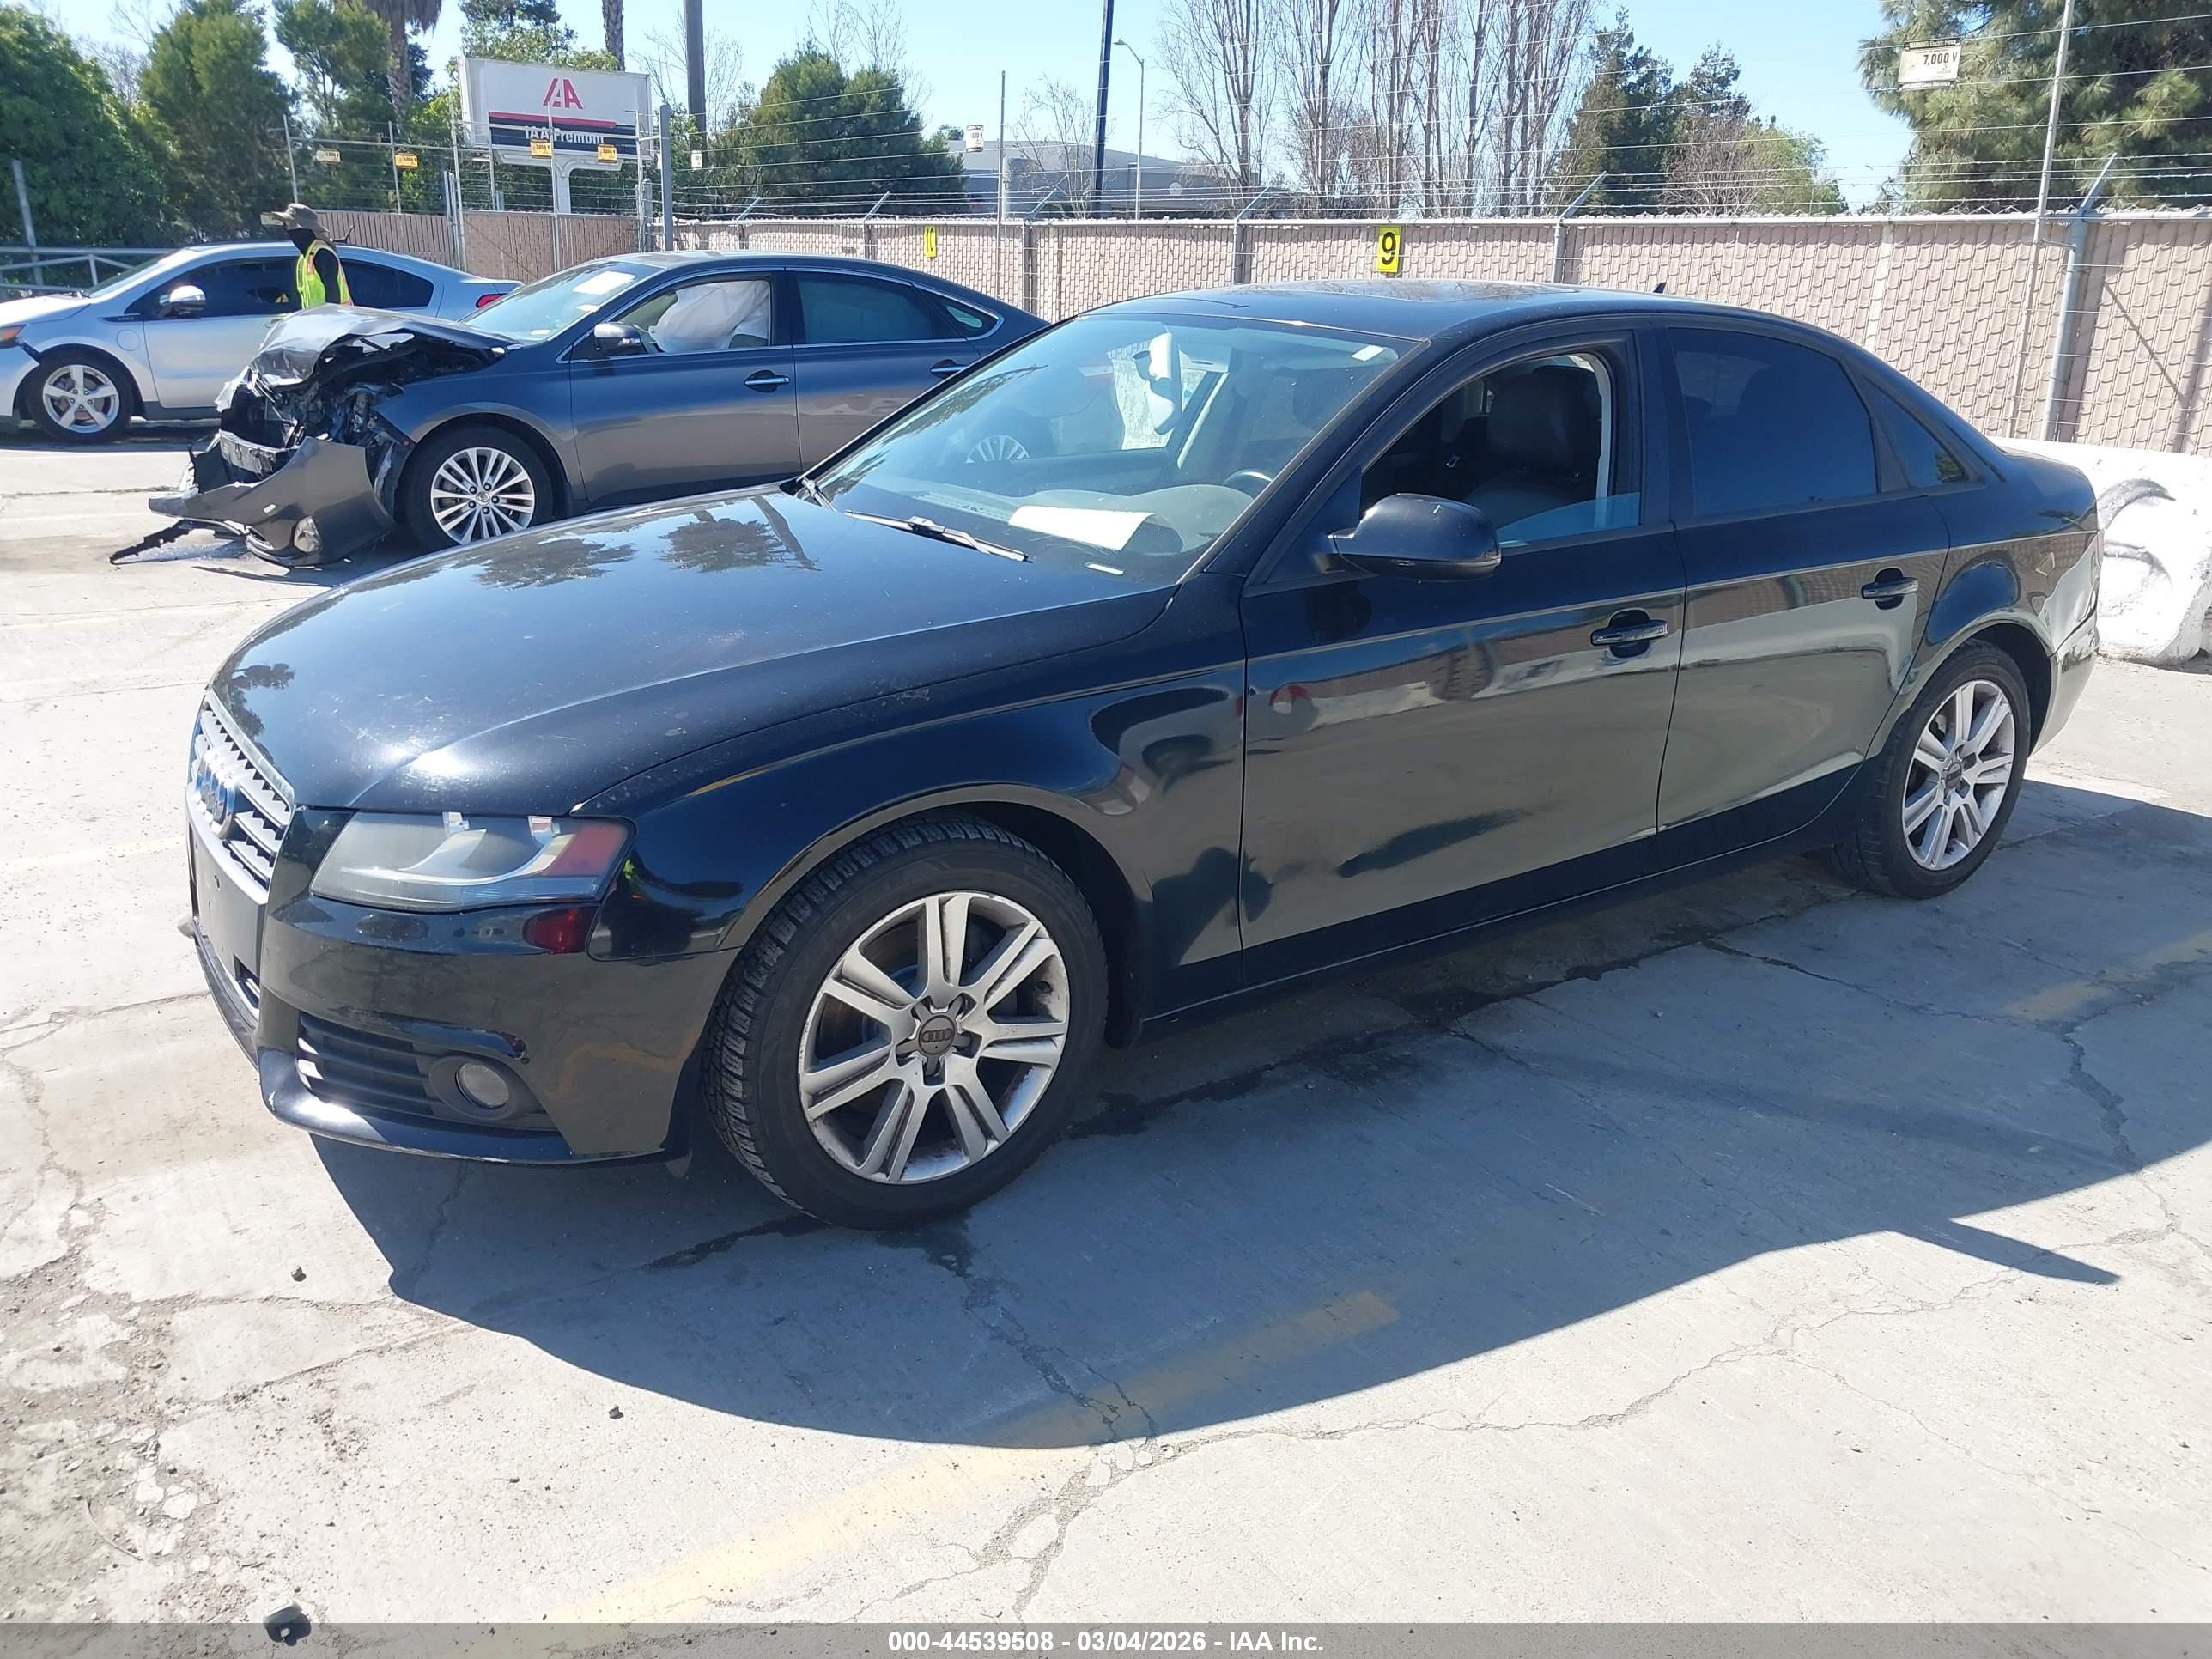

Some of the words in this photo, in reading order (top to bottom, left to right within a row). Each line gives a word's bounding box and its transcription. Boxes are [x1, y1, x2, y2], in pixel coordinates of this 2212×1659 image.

[1923, 52, 1949, 66] 7,000
[1952, 52, 1958, 63] V
[525, 125, 550, 140] IAA
[553, 128, 605, 145] Fremont
[926, 227, 934, 252] 10
[1381, 231, 1397, 265] 9
